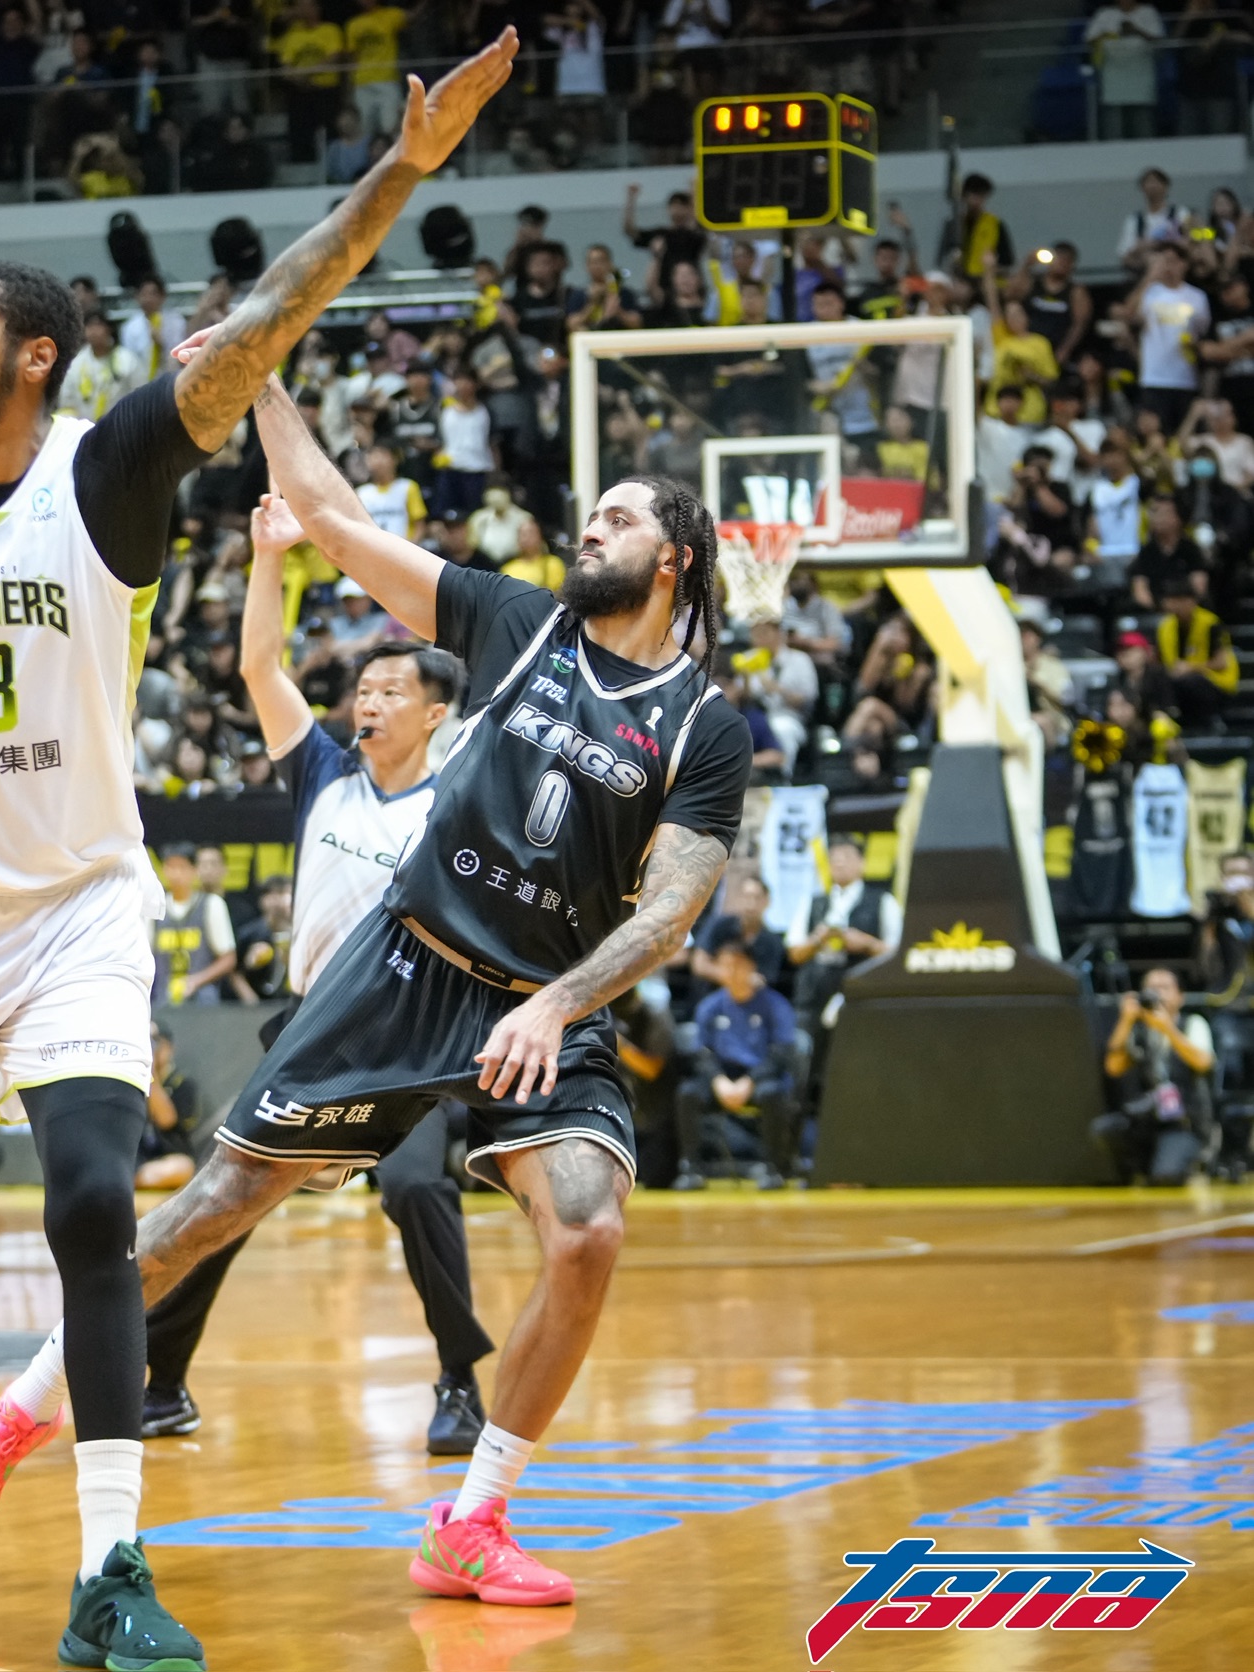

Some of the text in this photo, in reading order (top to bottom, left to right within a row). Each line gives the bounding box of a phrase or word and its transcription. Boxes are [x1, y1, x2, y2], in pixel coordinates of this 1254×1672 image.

[614, 723, 660, 757] SAMPO
[525, 769, 571, 847] 0
[313, 1103, 376, 1128] 永雄
